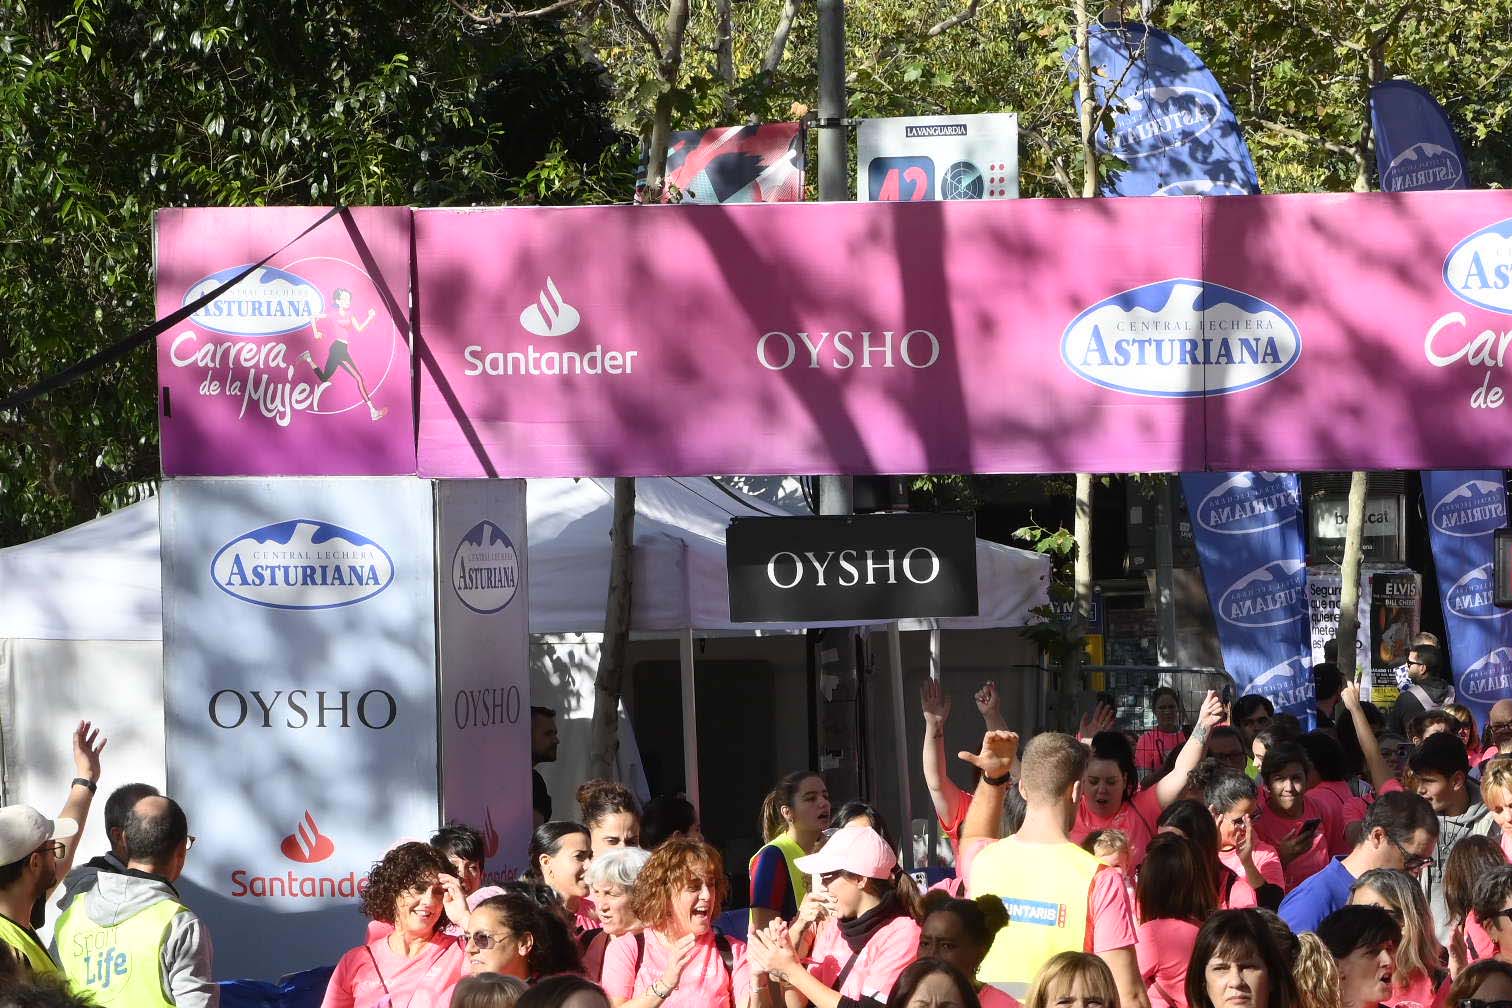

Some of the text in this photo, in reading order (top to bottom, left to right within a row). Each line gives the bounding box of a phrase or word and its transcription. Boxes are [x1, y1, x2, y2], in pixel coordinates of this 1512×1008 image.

[1116, 318, 1273, 331] CENTRAL LECHERA
[170, 330, 287, 369] Carrera
[464, 344, 638, 376] Santander
[755, 329, 941, 371] OYSHO
[1080, 324, 1283, 366] ASTURIANA
[200, 365, 332, 427] de la Mujer
[1470, 370, 1504, 408] de
[225, 553, 382, 587] ASTURIANA
[252, 551, 375, 560] CENTRAL LECHERA
[457, 556, 516, 591] ASTURIANA
[767, 546, 940, 589] OYSHO
[1385, 582, 1416, 596] ELVIS
[208, 688, 397, 729] OYSHO
[454, 684, 520, 730] OYSHO
[84, 946, 128, 989] Life
